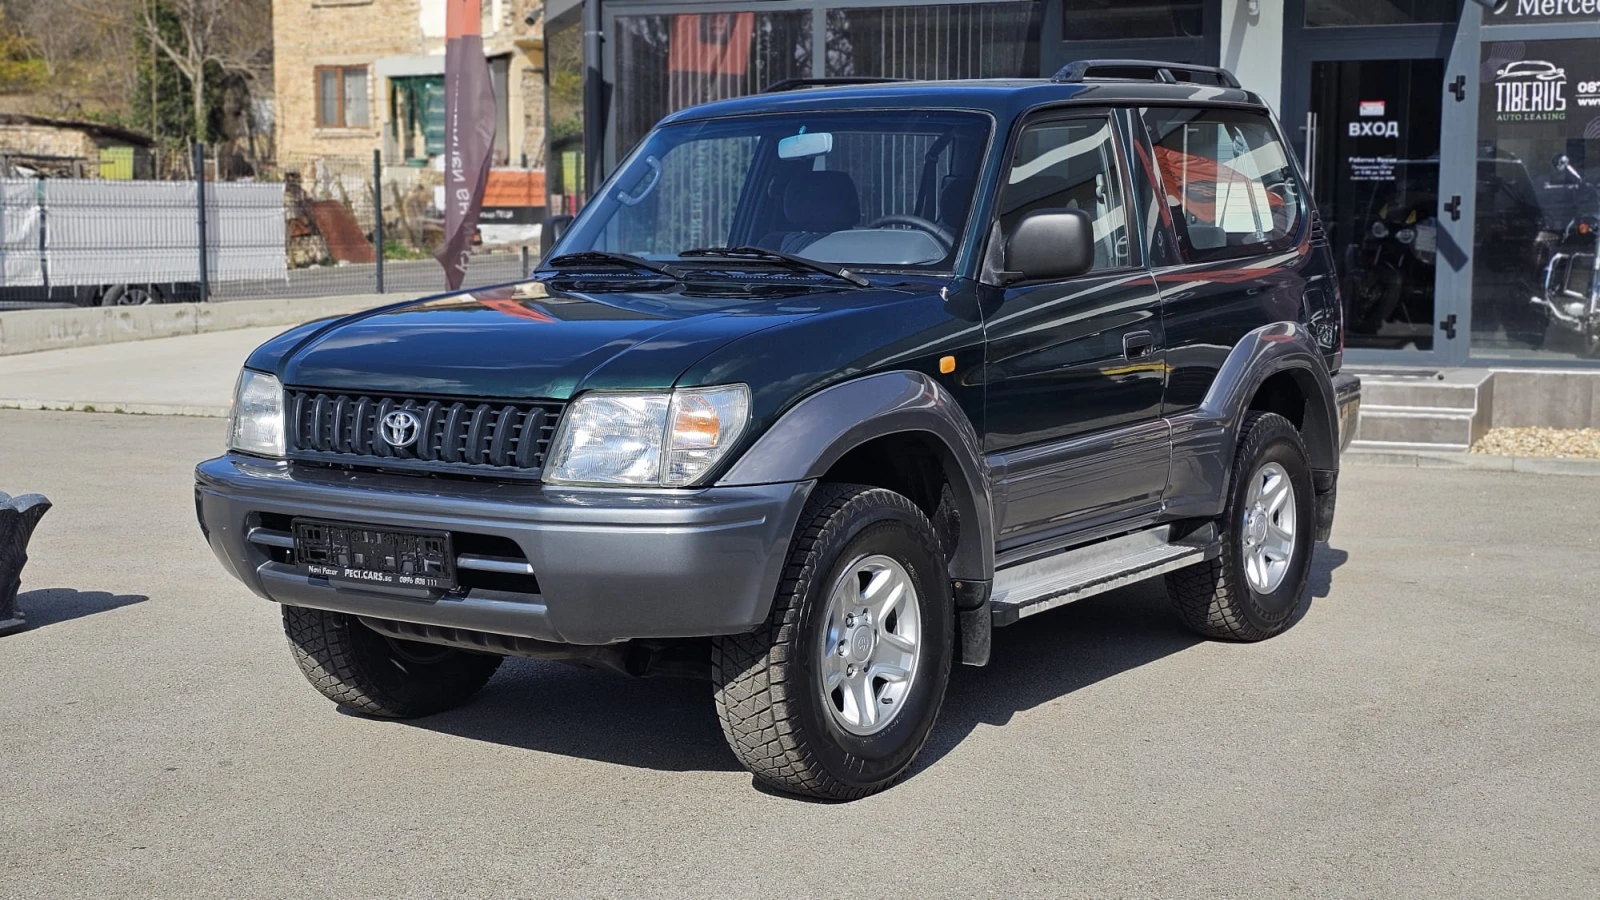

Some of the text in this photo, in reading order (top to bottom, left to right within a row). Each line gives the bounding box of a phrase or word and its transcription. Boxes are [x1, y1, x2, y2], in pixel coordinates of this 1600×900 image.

[1515, 0, 1600, 16] Merce
[1495, 81, 1567, 112] TIBERUS
[1496, 112, 1566, 121] AUTO LEASING
[1348, 121, 1399, 138] ВХОД
[427, 578, 437, 587] 111
